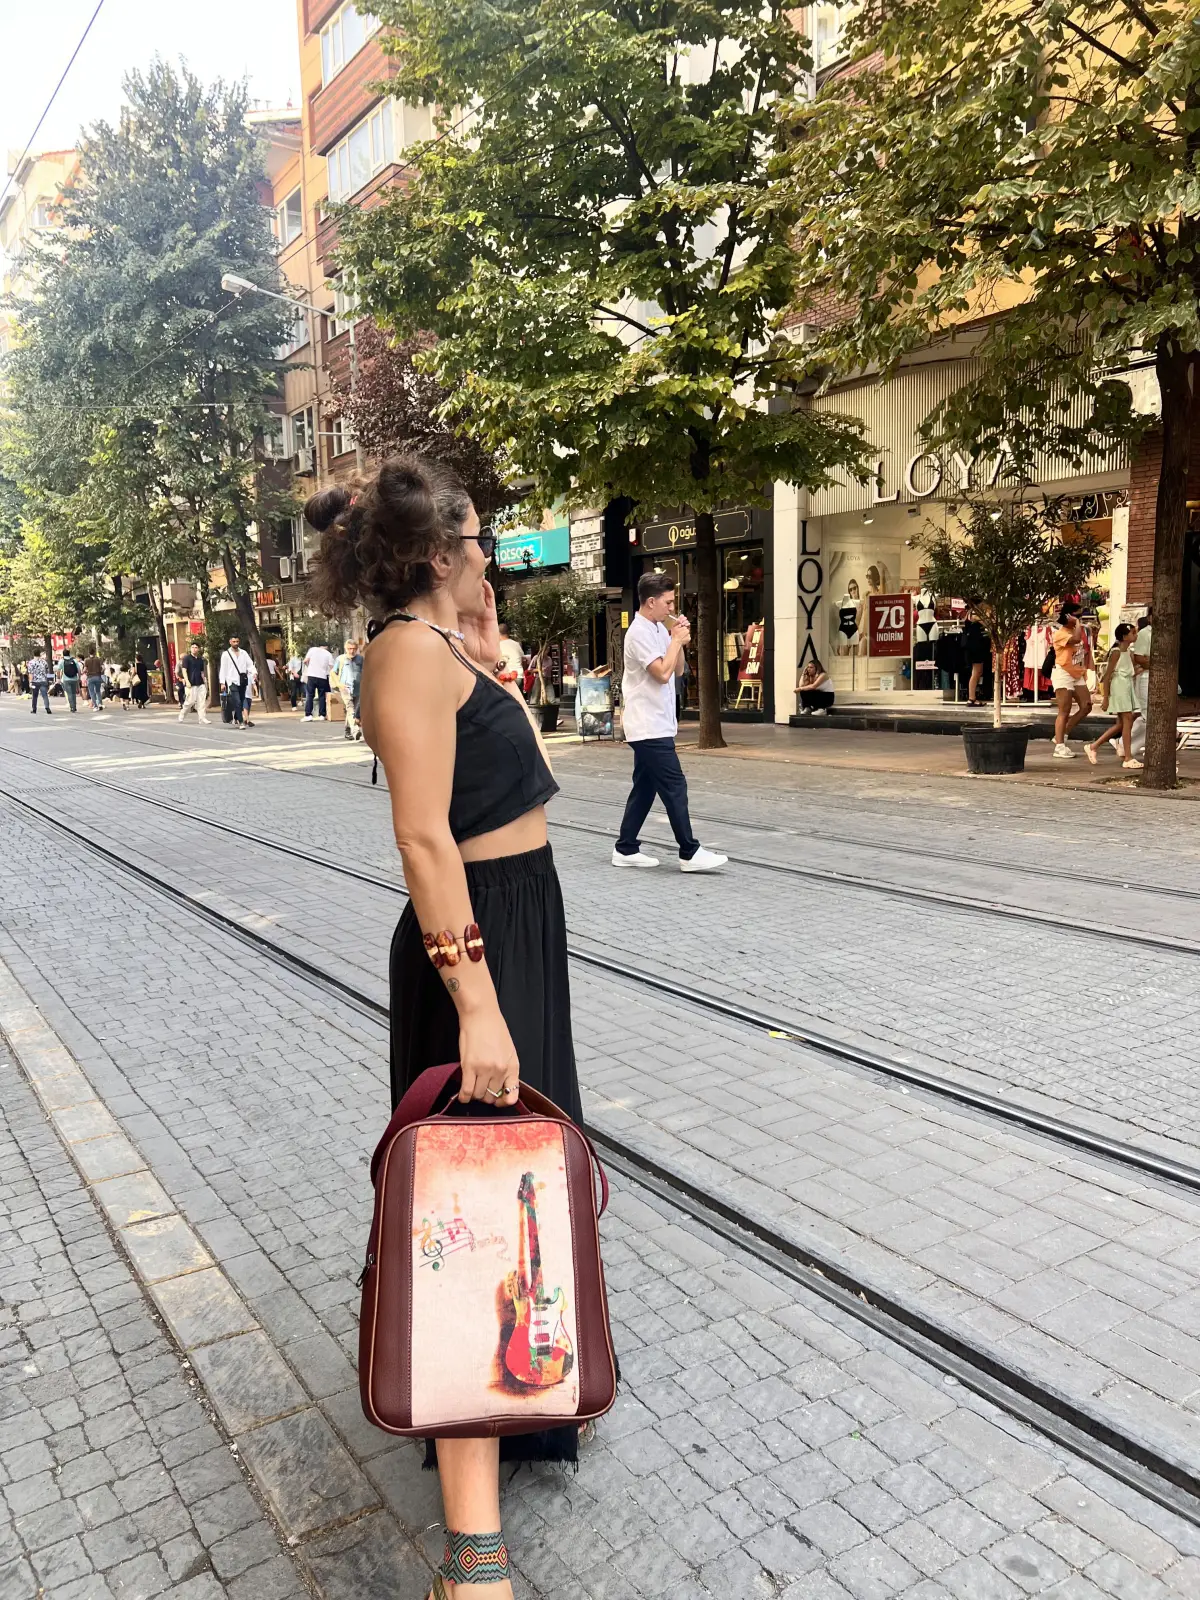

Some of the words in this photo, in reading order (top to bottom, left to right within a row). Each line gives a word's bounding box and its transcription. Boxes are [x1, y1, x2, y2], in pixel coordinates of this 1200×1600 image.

[797, 520, 823, 668] LOYA
[875, 605, 905, 629] 70
[876, 631, 904, 642] İNDİRİM
